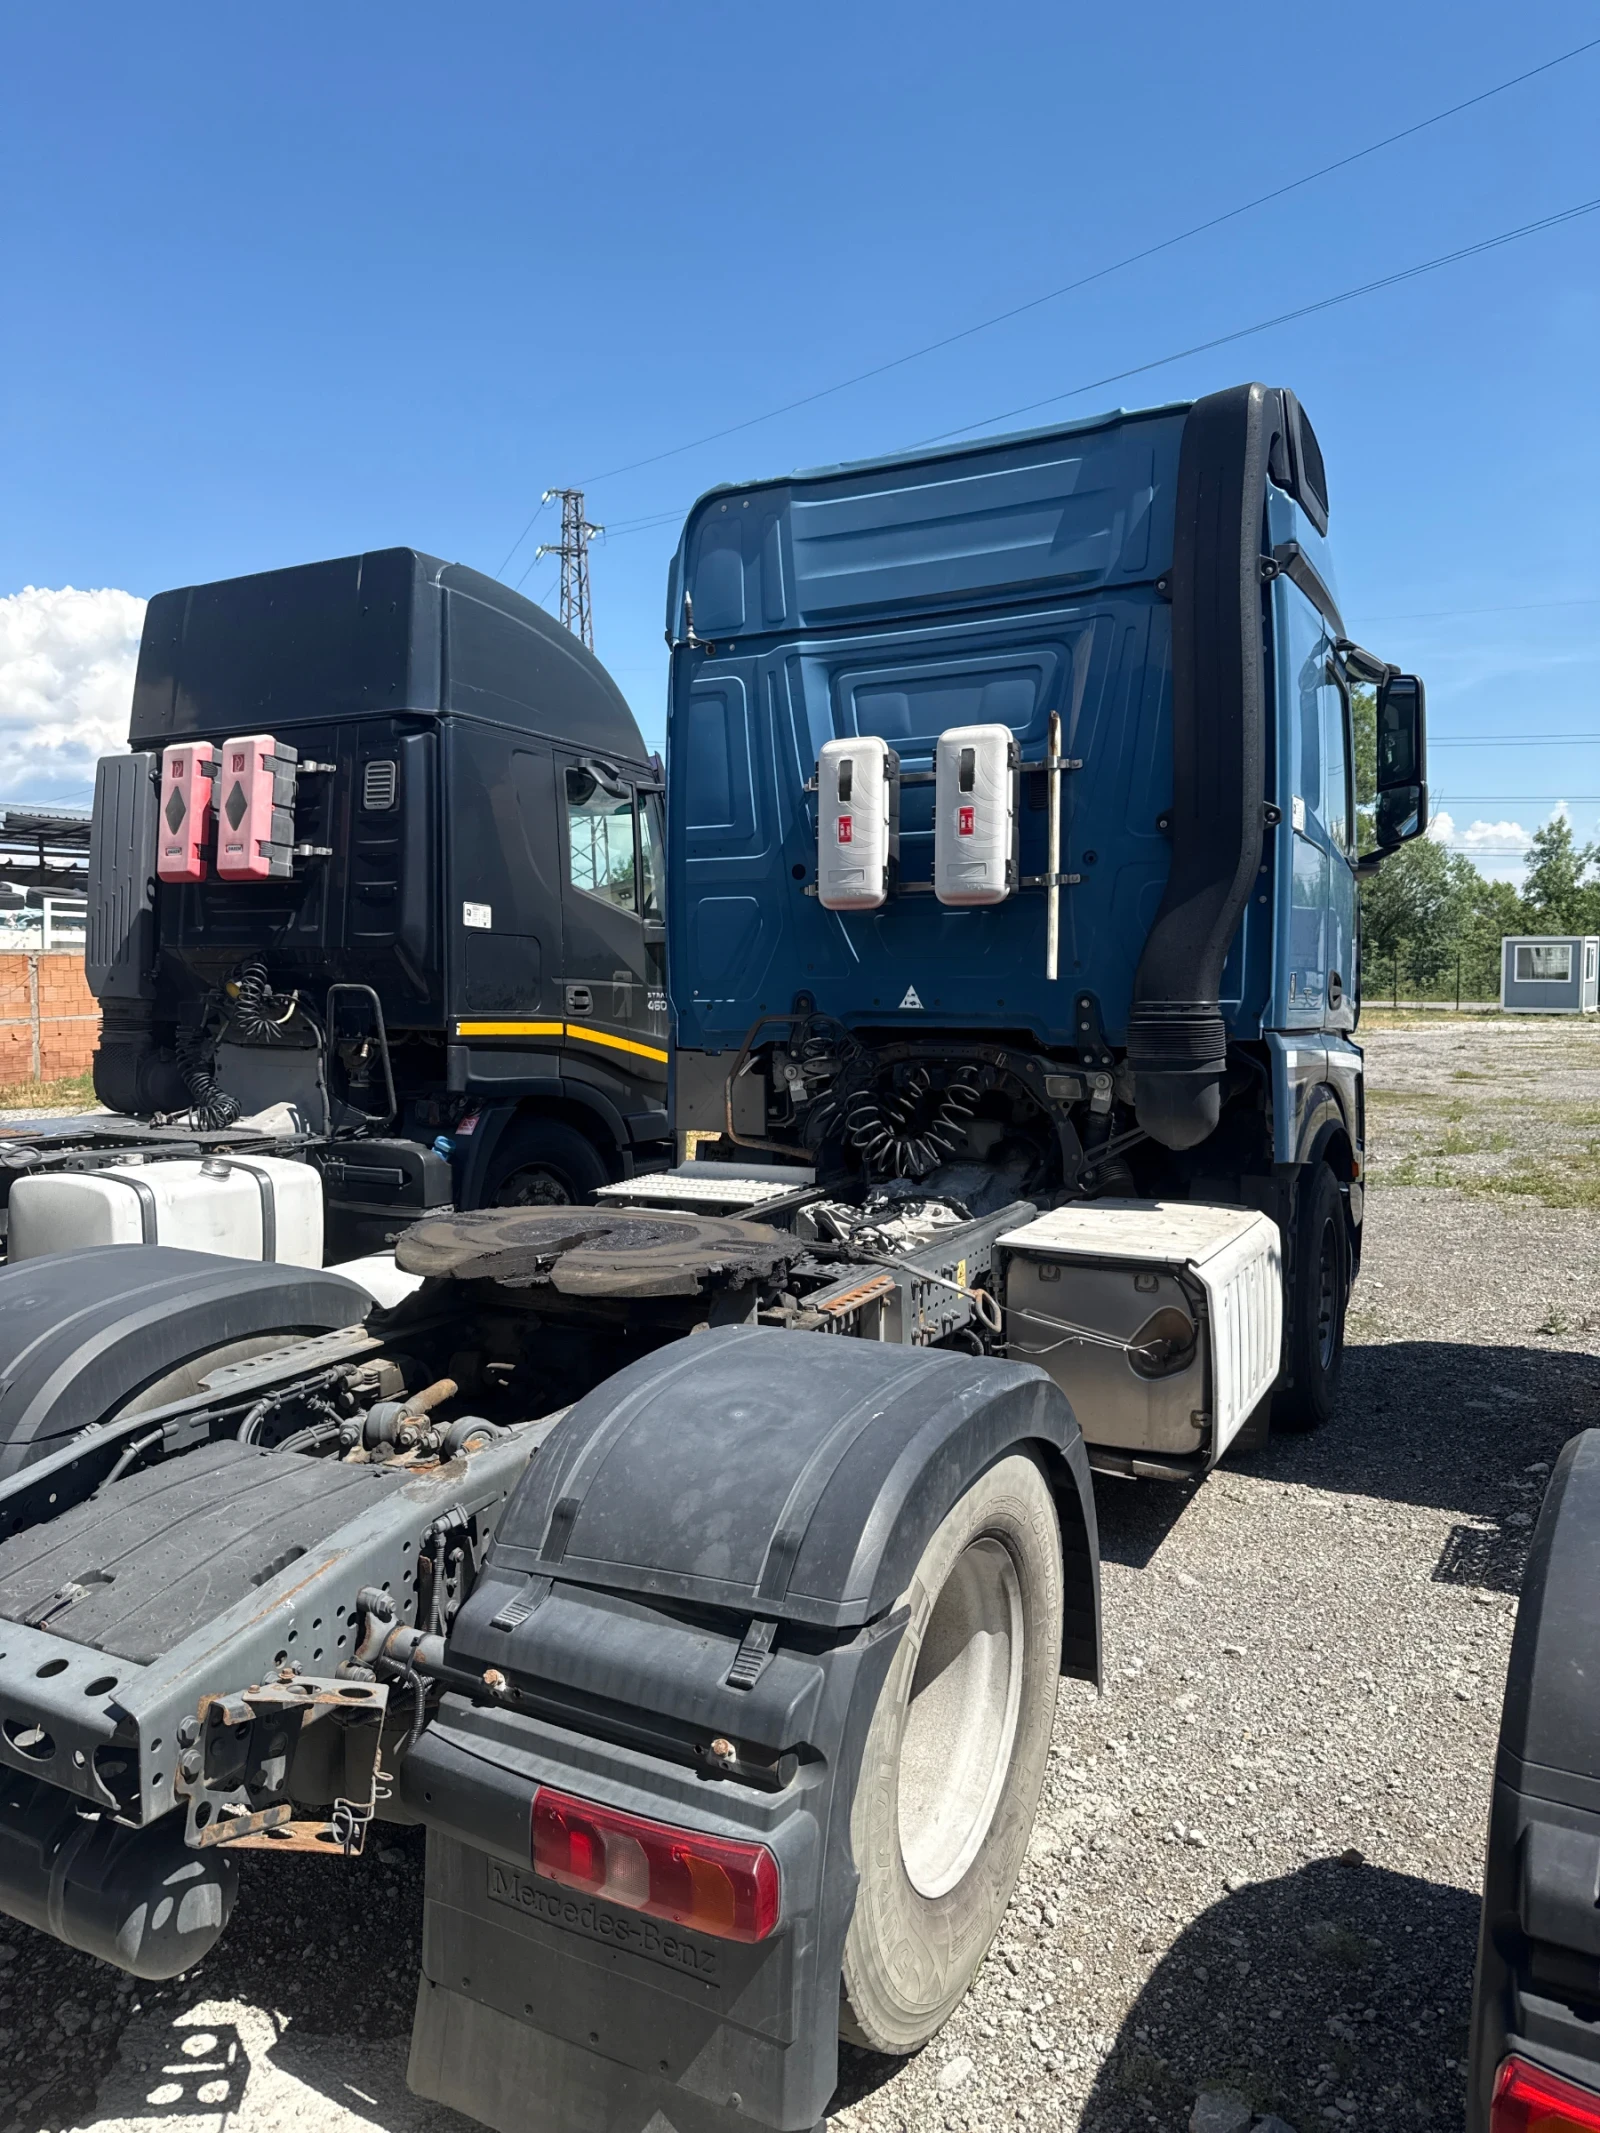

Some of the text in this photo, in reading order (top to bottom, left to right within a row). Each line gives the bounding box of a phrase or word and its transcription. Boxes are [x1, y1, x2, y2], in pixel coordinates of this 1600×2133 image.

[647, 1000, 668, 1011] 460
[1031, 1503, 1059, 1741] BRIDGESTONE
[492, 1866, 716, 1974] Mercedes-Benz
